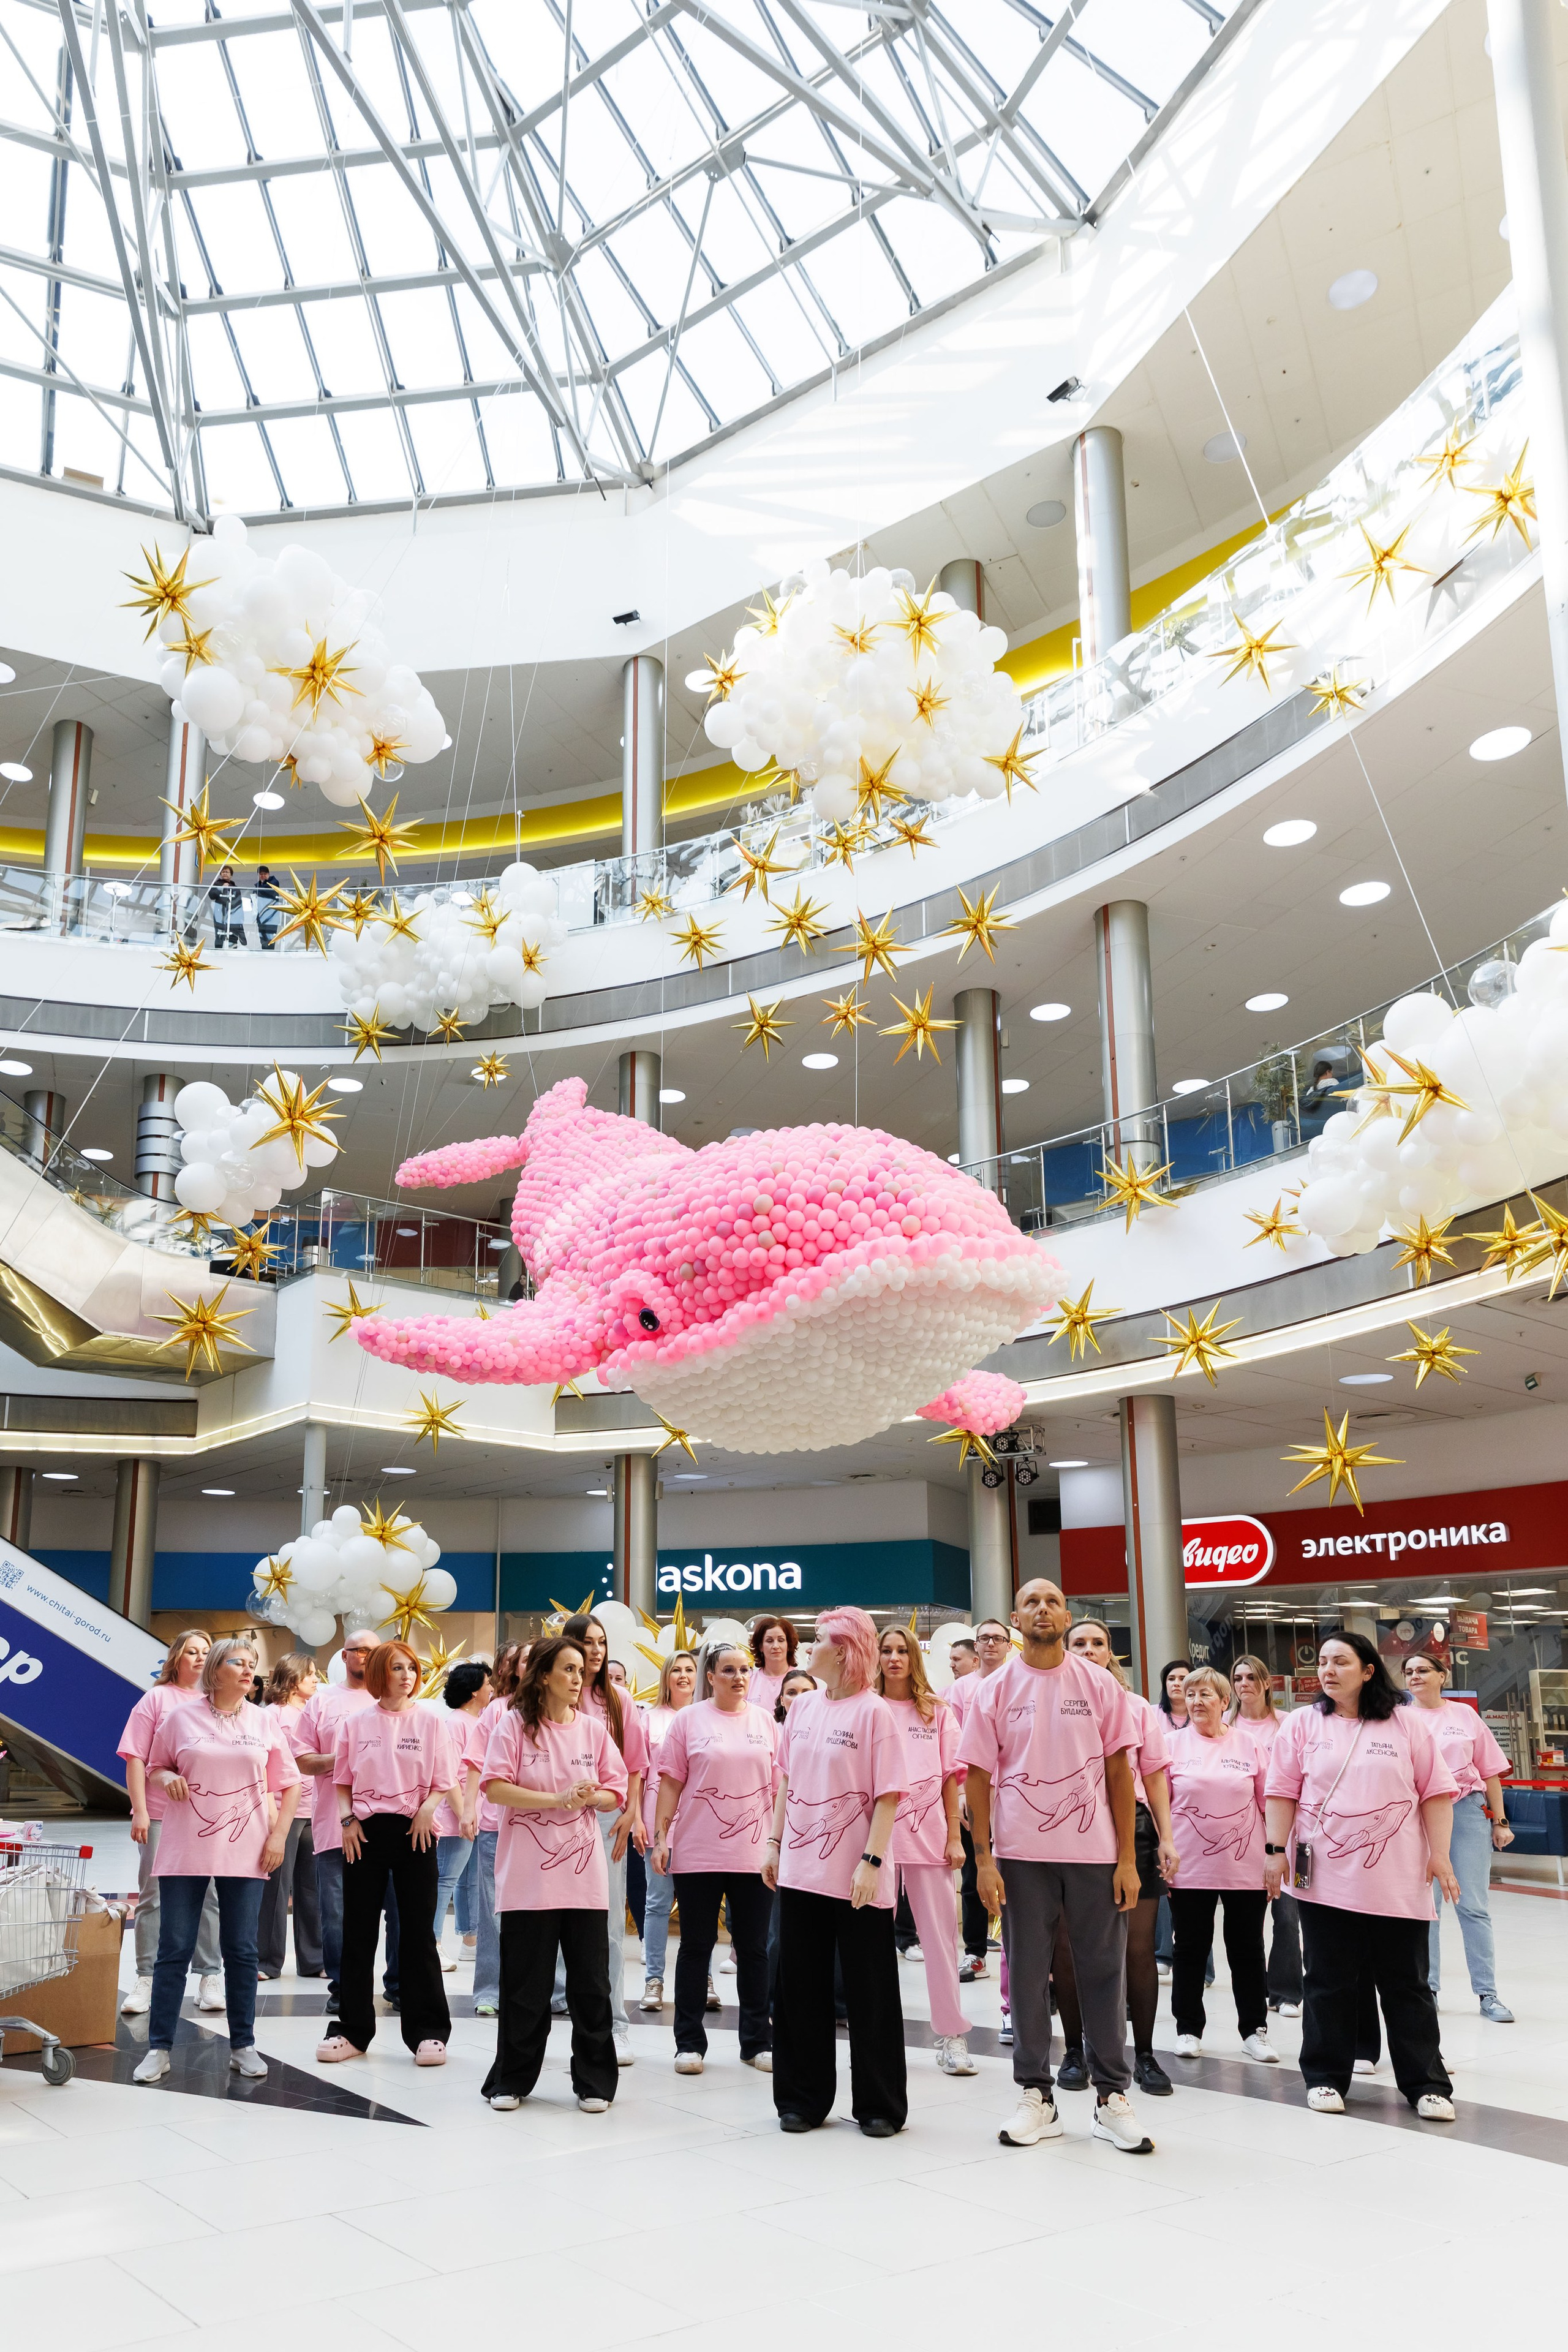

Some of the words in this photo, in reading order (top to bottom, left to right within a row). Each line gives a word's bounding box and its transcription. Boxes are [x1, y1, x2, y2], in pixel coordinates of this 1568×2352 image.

[1301, 1521, 1507, 1561] электроника
[658, 1554, 802, 1593] askona
[27, 1585, 111, 1643] www.chitai-gorod.ru
[1457, 1615, 1479, 1625] ВЫДАЧА
[1458, 1625, 1478, 1635] ТОВАРА
[1060, 1708, 1092, 1716] БУЛДАКОВ
[832, 1730, 854, 1740] ПОЛИНА
[826, 1737, 858, 1750] ЛУЩЕНКОВА
[1366, 1749, 1398, 1758] АКСЕНОВА
